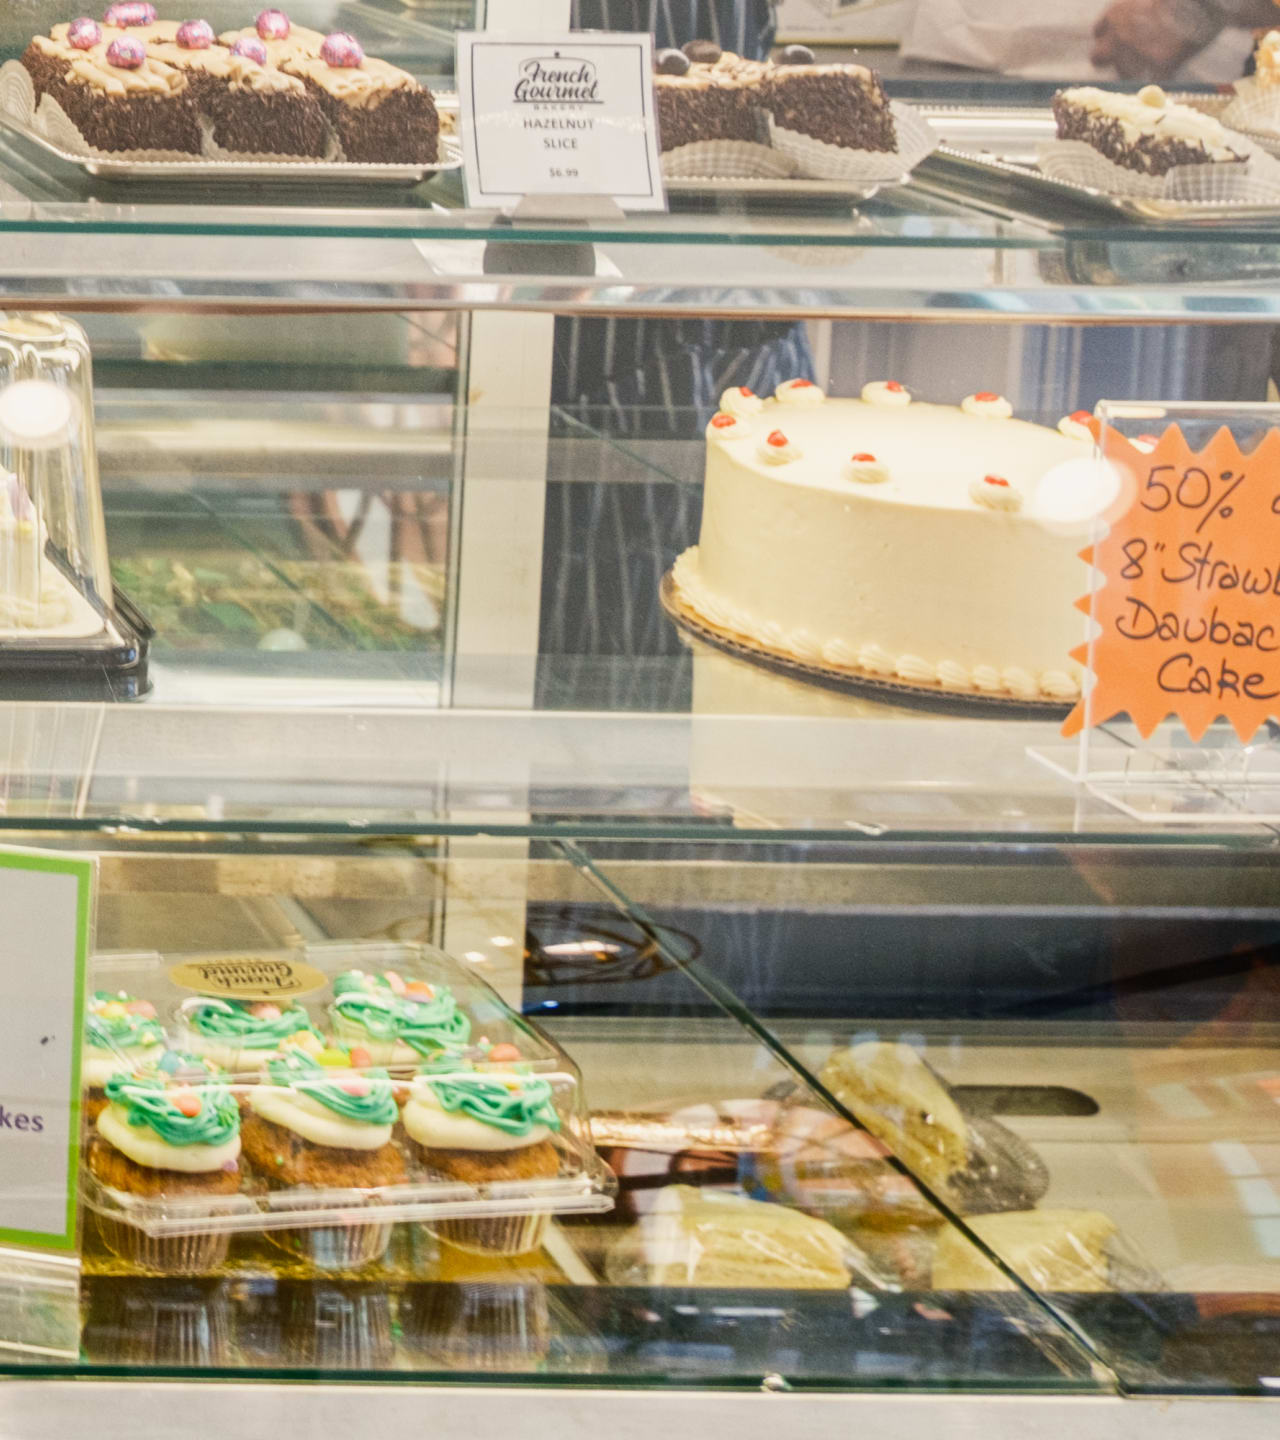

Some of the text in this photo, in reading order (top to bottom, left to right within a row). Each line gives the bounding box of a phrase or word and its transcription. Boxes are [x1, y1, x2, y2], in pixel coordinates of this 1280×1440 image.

[525, 61, 590, 83] French
[514, 80, 598, 101] Gourmet
[523, 119, 594, 129] HAZELNUT
[544, 139, 578, 149] SLICE
[550, 168, 578, 178] $6.99
[1140, 465, 1244, 534] 50%
[1157, 652, 1280, 700] Cake
